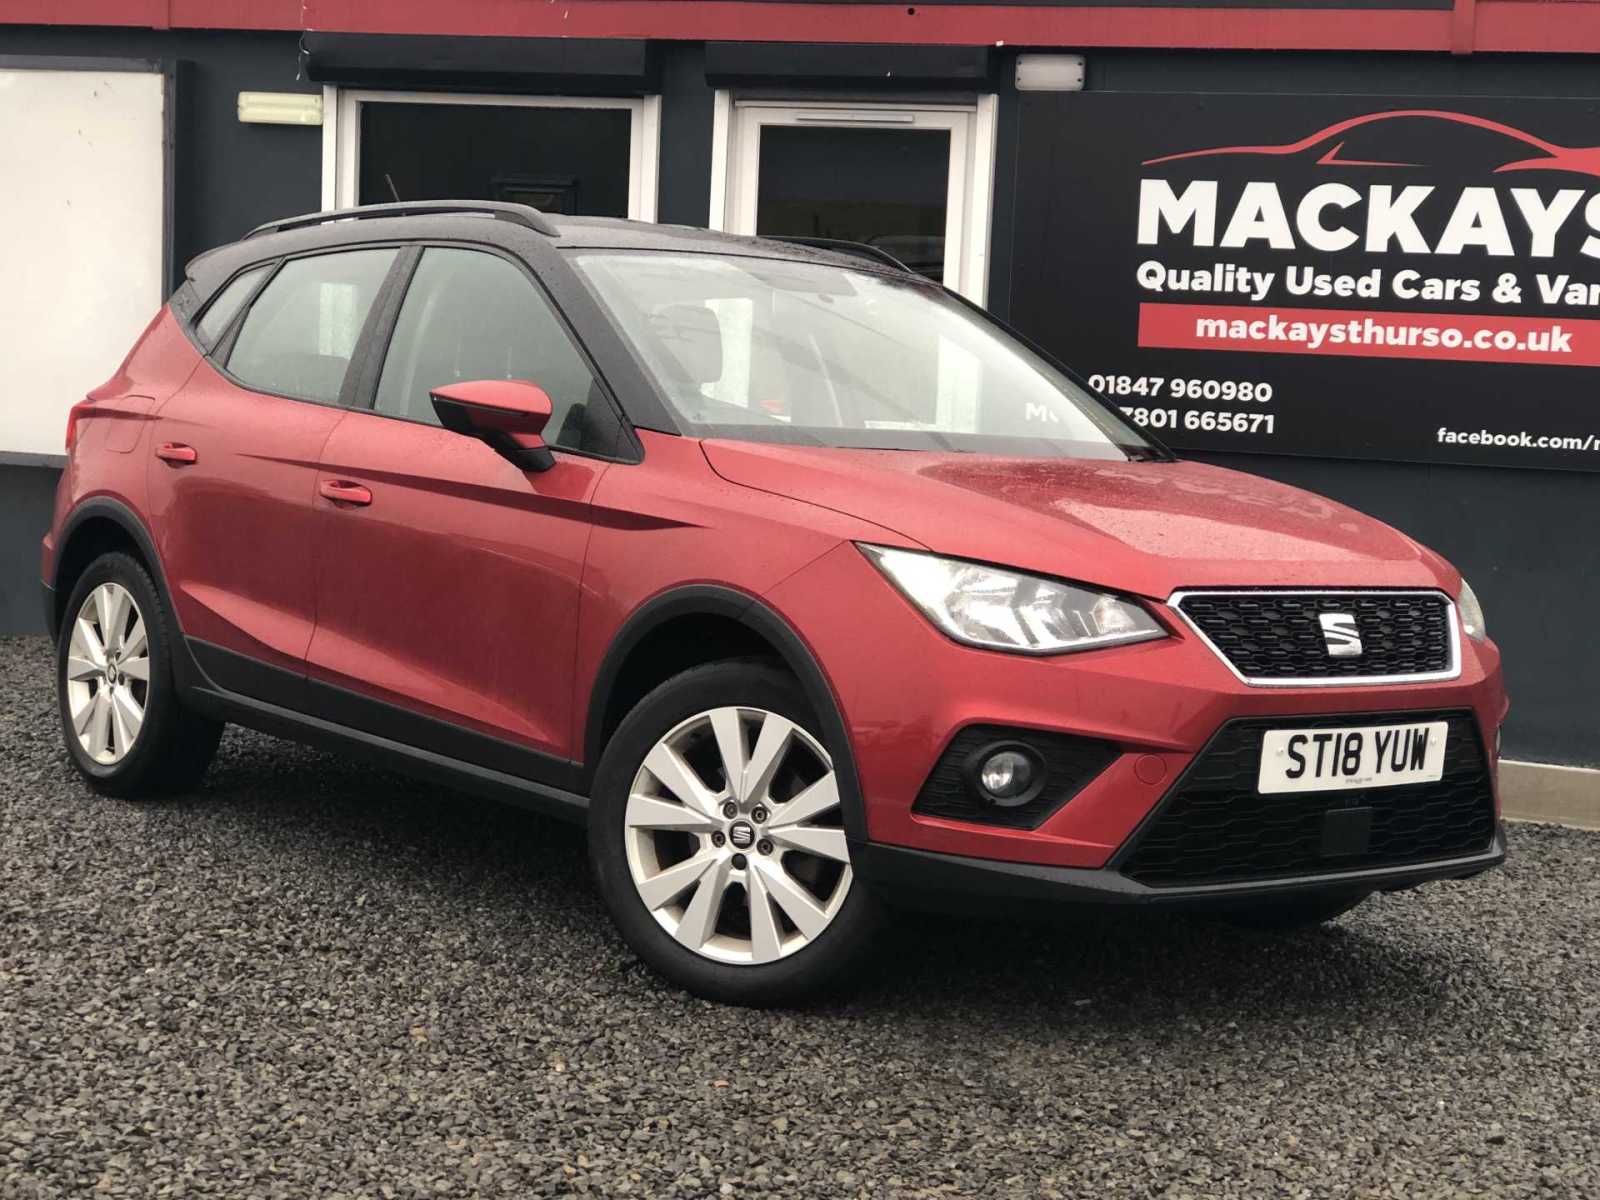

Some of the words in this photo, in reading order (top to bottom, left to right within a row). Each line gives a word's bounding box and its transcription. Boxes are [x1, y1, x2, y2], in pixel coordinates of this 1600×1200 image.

[1136, 260, 1275, 301] Quality
[1286, 265, 1382, 298] Used
[1392, 269, 1481, 302] Cars
[1492, 272, 1521, 304] &
[1196, 314, 1573, 353] mackaysthurso.co.uk
[1088, 374, 1165, 397] 01847
[1170, 378, 1273, 402] 960980
[1184, 410, 1275, 434] 665671
[1285, 732, 1363, 779] ST18
[1375, 727, 1430, 774] YUW
